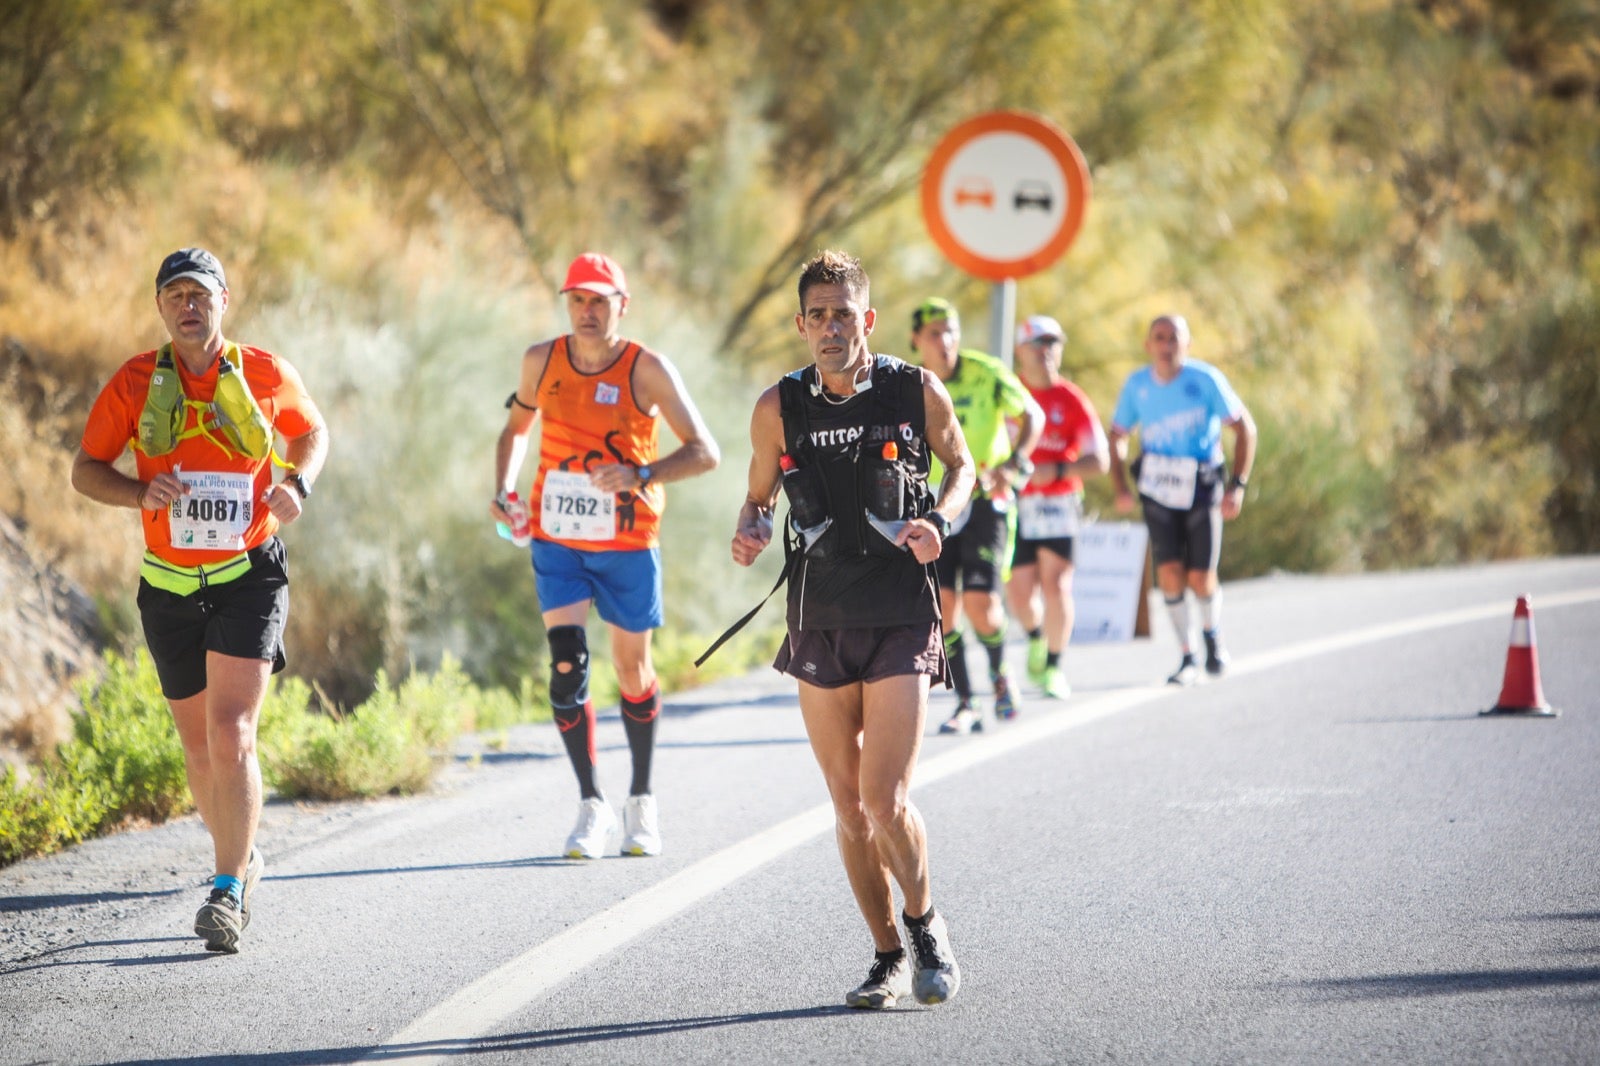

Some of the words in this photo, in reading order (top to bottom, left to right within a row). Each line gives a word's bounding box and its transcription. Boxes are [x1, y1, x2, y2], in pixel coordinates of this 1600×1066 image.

[209, 480, 226, 488] PICO
[228, 480, 249, 489] VELETA
[186, 498, 238, 522] 4087
[556, 495, 598, 516] 7262
